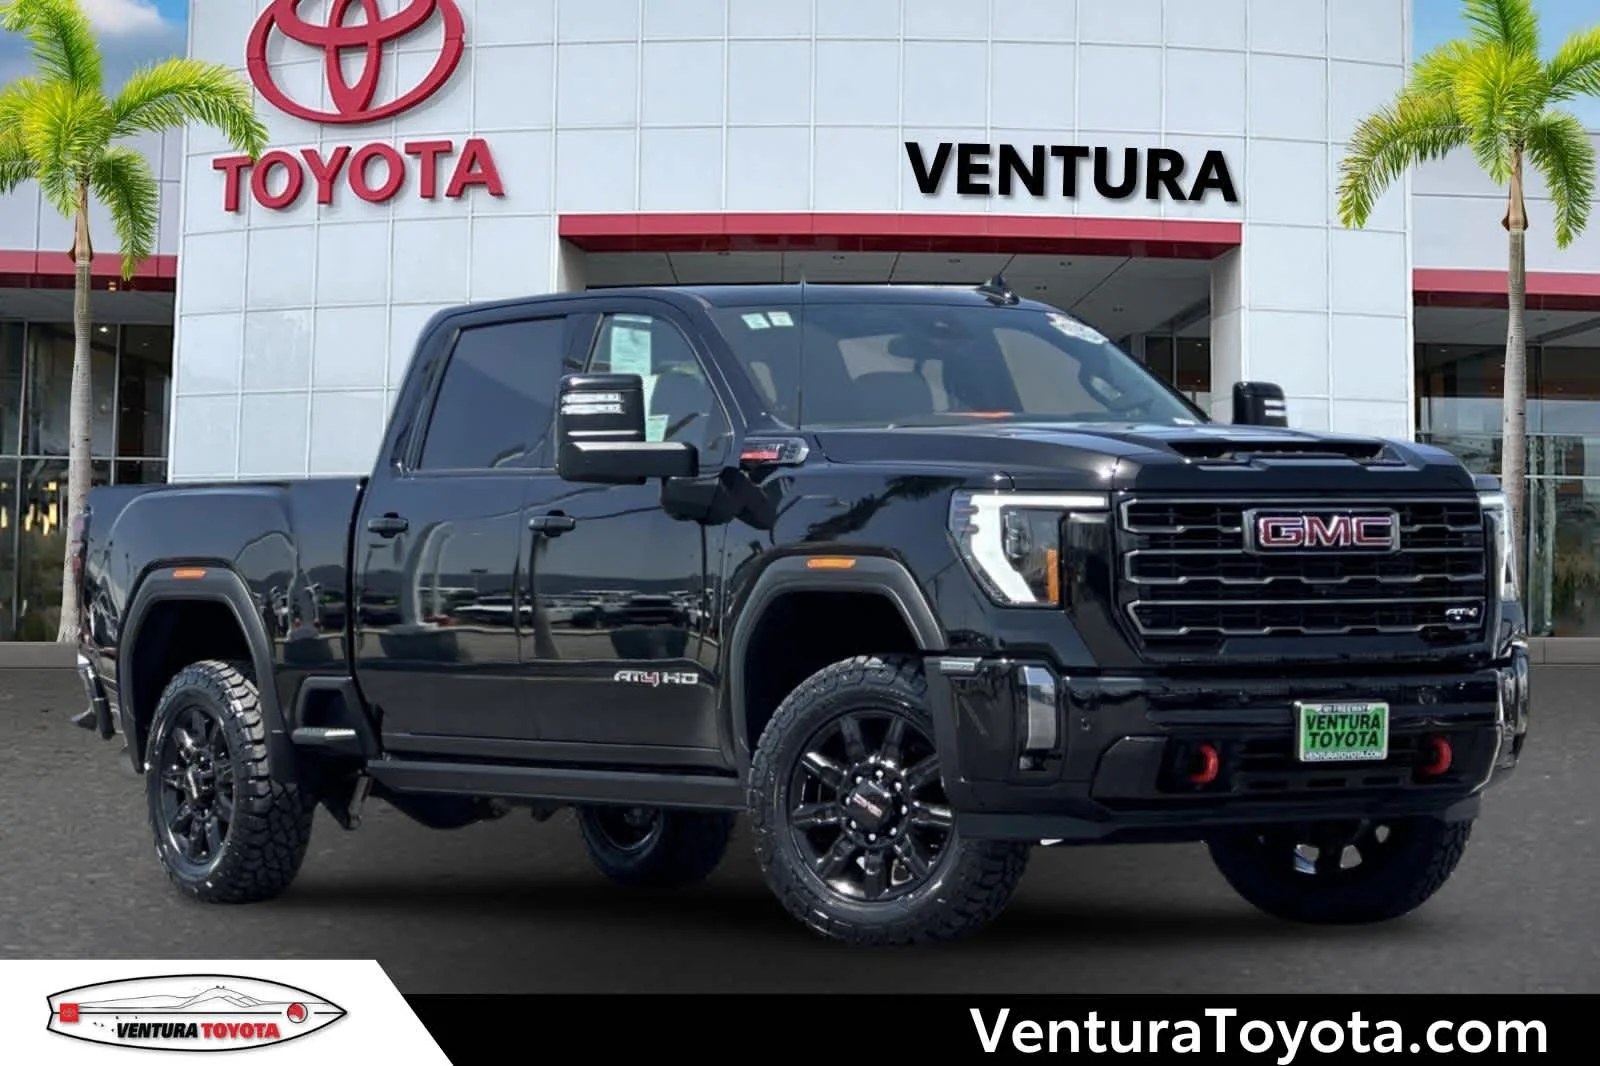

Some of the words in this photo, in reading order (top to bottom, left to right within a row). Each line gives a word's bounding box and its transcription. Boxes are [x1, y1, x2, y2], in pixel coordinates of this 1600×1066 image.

[213, 139, 504, 212] TOYOTA
[905, 142, 1238, 202] VENTURA
[1259, 515, 1392, 547] GMC
[662, 672, 699, 684] HD
[1306, 714, 1381, 730] VENTURA
[1309, 731, 1379, 748] TOYOTA
